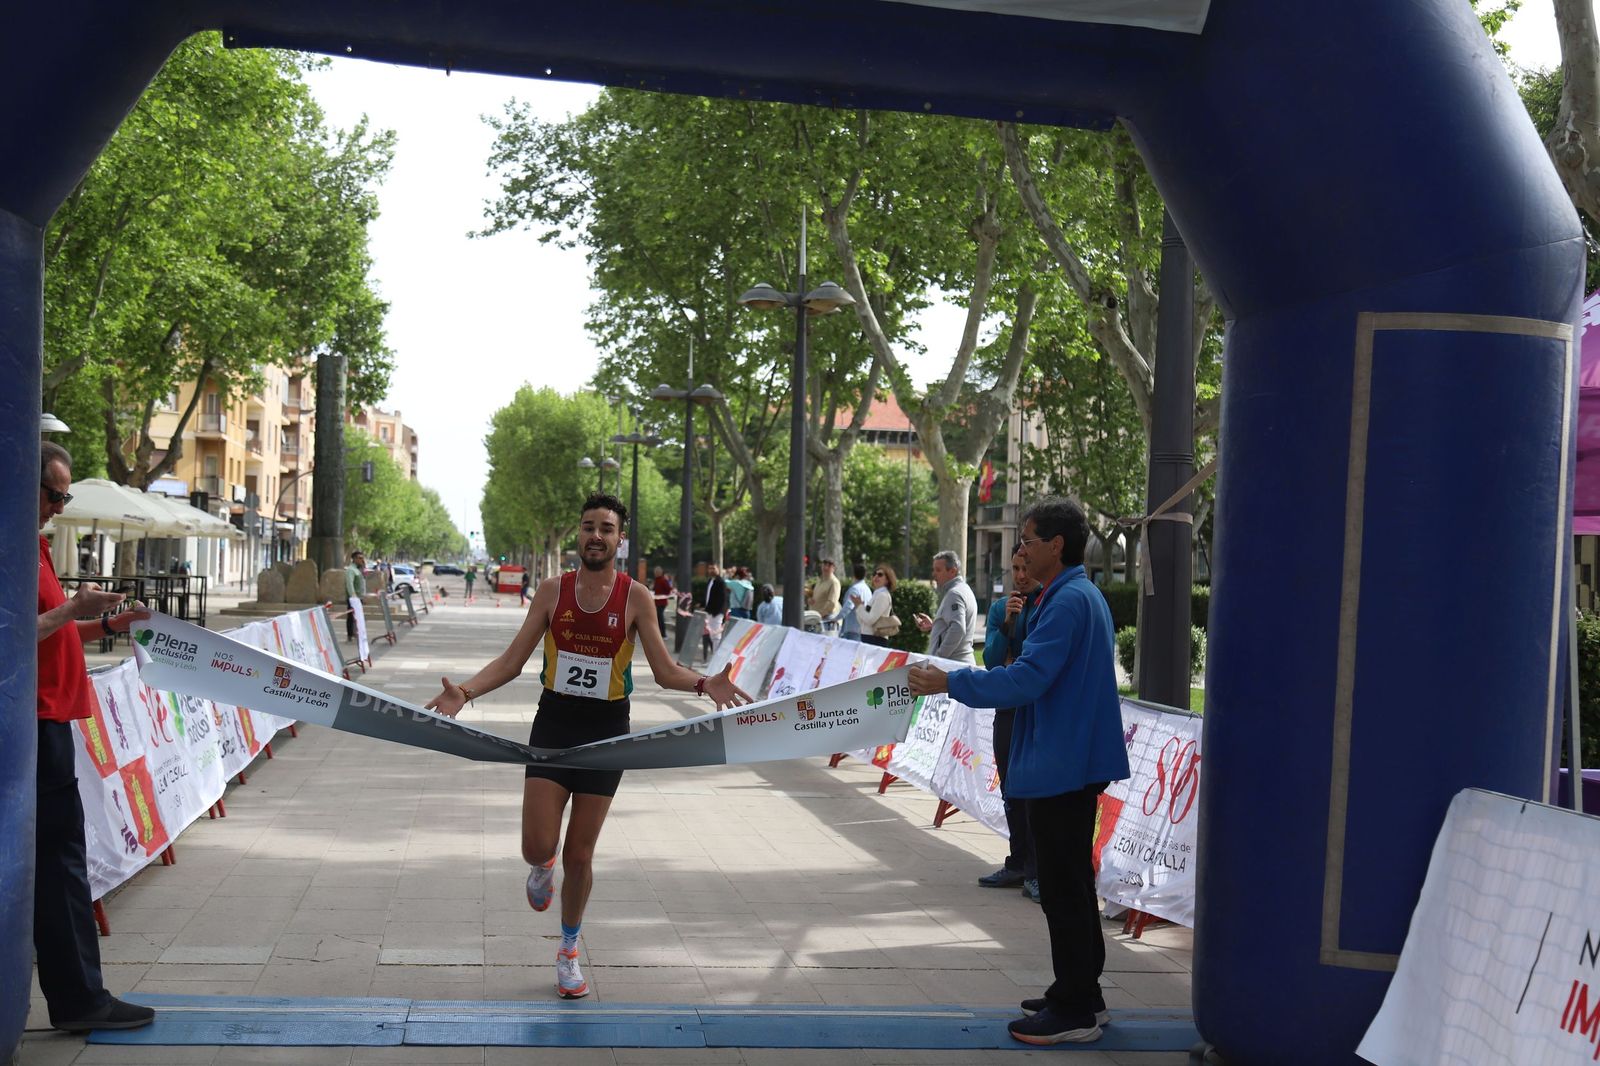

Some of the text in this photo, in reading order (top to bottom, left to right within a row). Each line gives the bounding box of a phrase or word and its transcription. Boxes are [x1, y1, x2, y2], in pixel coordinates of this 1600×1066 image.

[154, 632, 198, 655] Plena
[574, 644, 599, 654] VINO
[152, 645, 194, 662] inclusión
[214, 651, 234, 662] NOS
[210, 659, 260, 678] IMPULSA
[566, 666, 598, 688] 25
[263, 685, 329, 709] Castilla y León
[290, 683, 332, 700] Junta de
[886, 684, 910, 698] Ple
[888, 698, 910, 708] inclu
[736, 712, 786, 726] IMPULSA
[818, 707, 858, 720] Junta de
[794, 716, 860, 732] Castilla y León
[1136, 844, 1144, 859] Y
[1180, 842, 1191, 853] de
[1560, 979, 1600, 1061] IM
